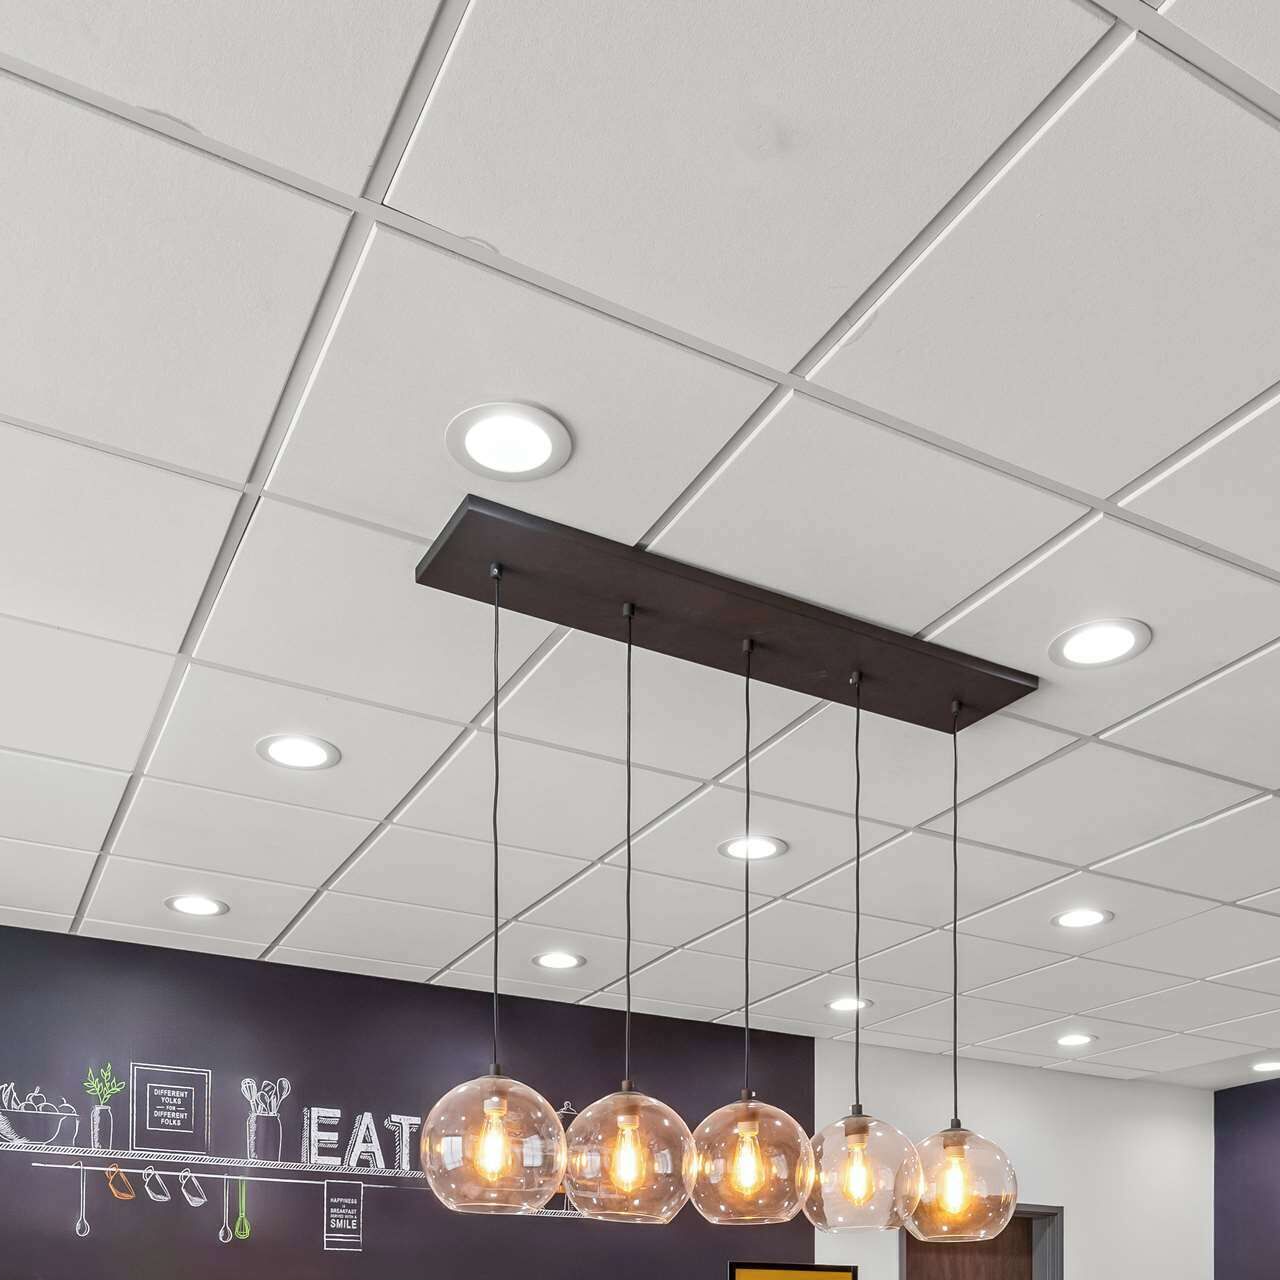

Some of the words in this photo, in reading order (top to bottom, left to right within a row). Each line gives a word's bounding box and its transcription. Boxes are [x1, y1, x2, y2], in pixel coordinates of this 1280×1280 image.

[154, 1089, 188, 1098] DIFFERENT
[153, 1110, 188, 1119] DIFFERENT
[160, 1118, 181, 1126] FOLKS
[301, 1107, 422, 1171] EAT
[330, 1218, 358, 1229] SMILE
